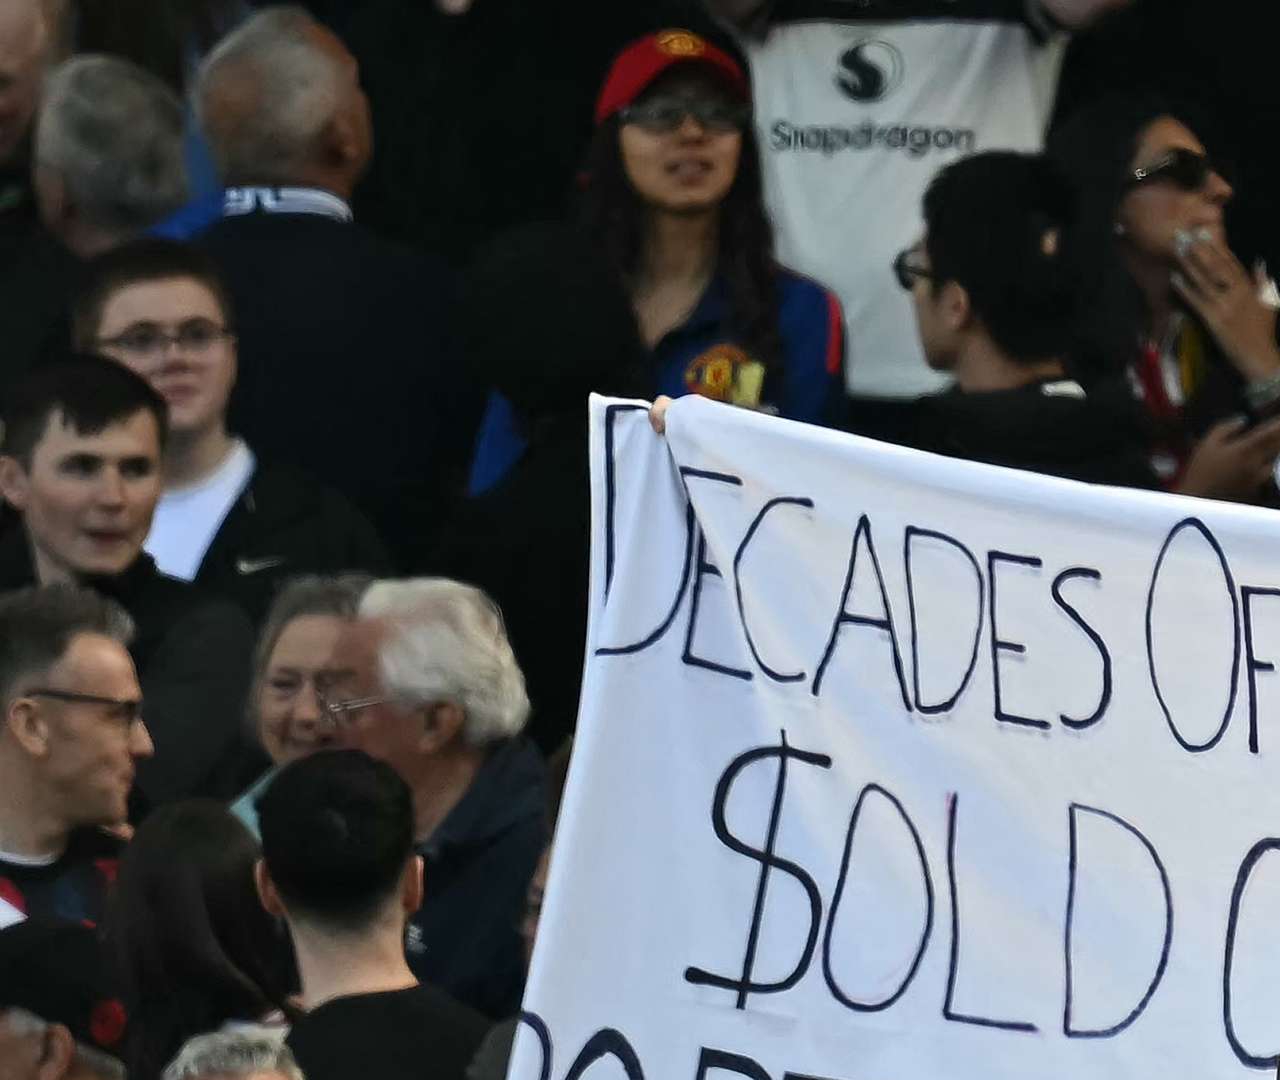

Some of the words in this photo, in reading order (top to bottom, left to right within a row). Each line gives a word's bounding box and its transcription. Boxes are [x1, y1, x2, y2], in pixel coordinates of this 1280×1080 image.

[771, 119, 977, 161] Snapdragon
[595, 403, 1113, 731] DECADES
[685, 728, 1174, 1039] $OLD
